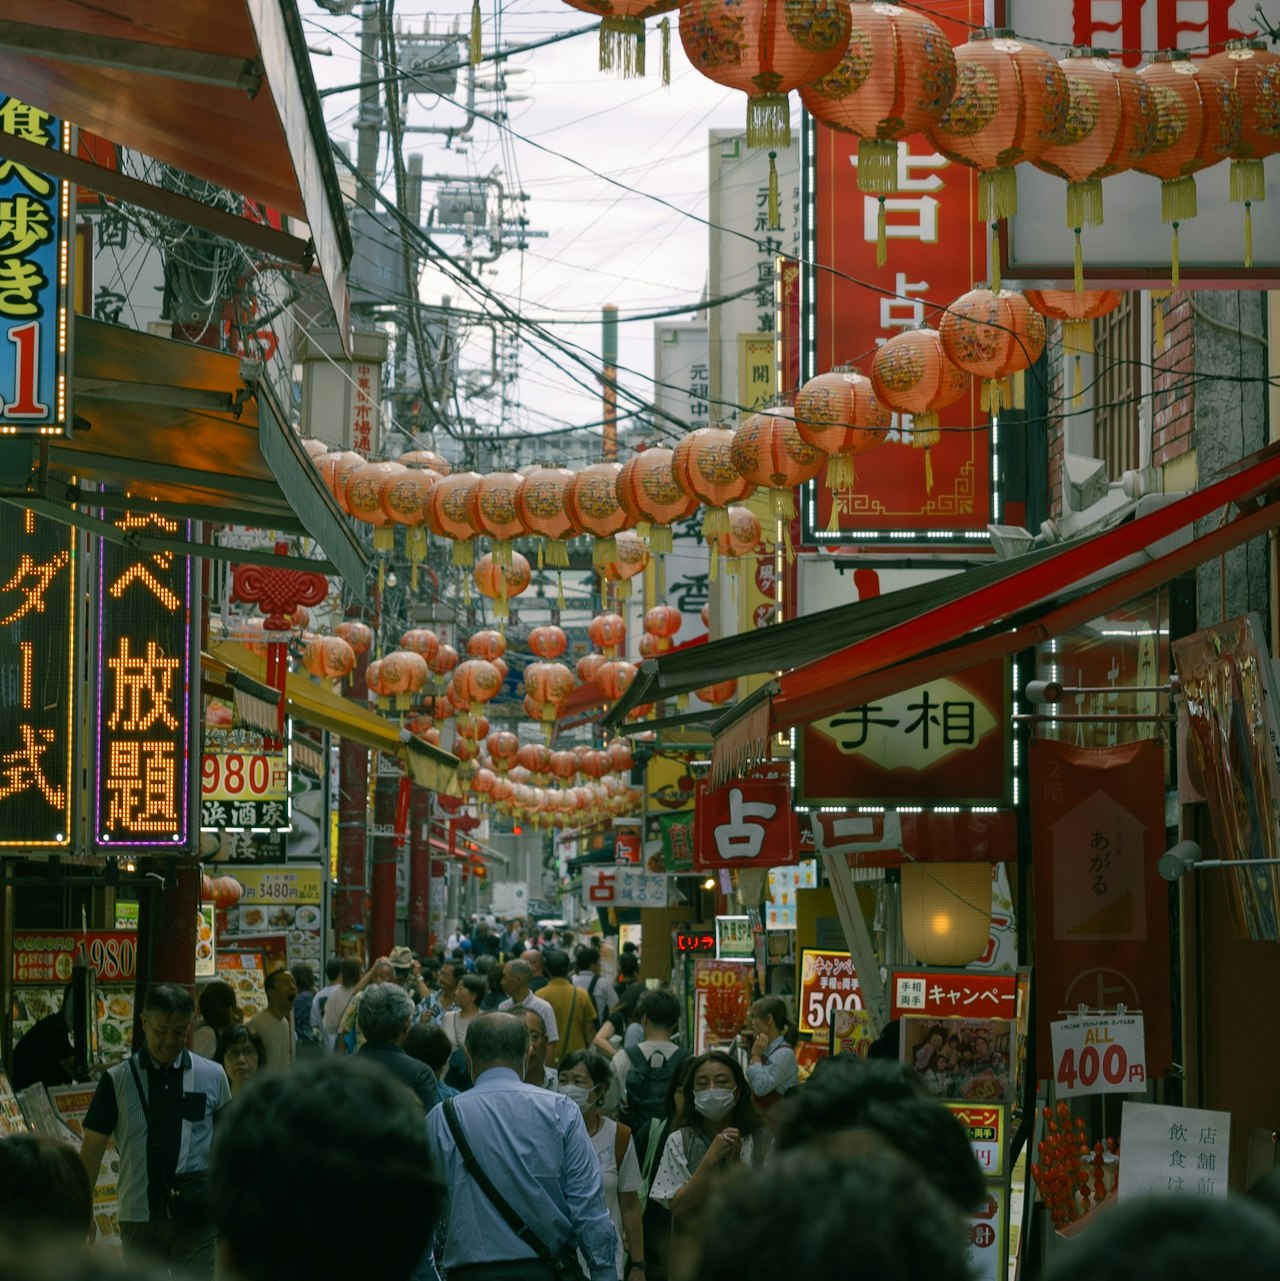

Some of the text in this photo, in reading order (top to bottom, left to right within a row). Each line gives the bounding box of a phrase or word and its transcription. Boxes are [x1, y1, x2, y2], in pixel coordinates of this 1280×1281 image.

[829, 690, 975, 750] 手相
[713, 787, 778, 860] 占
[1088, 829, 1112, 896] あがる
[590, 872, 616, 902] 占
[697, 970, 737, 987] 500
[1084, 1026, 1115, 1045] ALL
[1057, 1043, 1146, 1090] 400円
